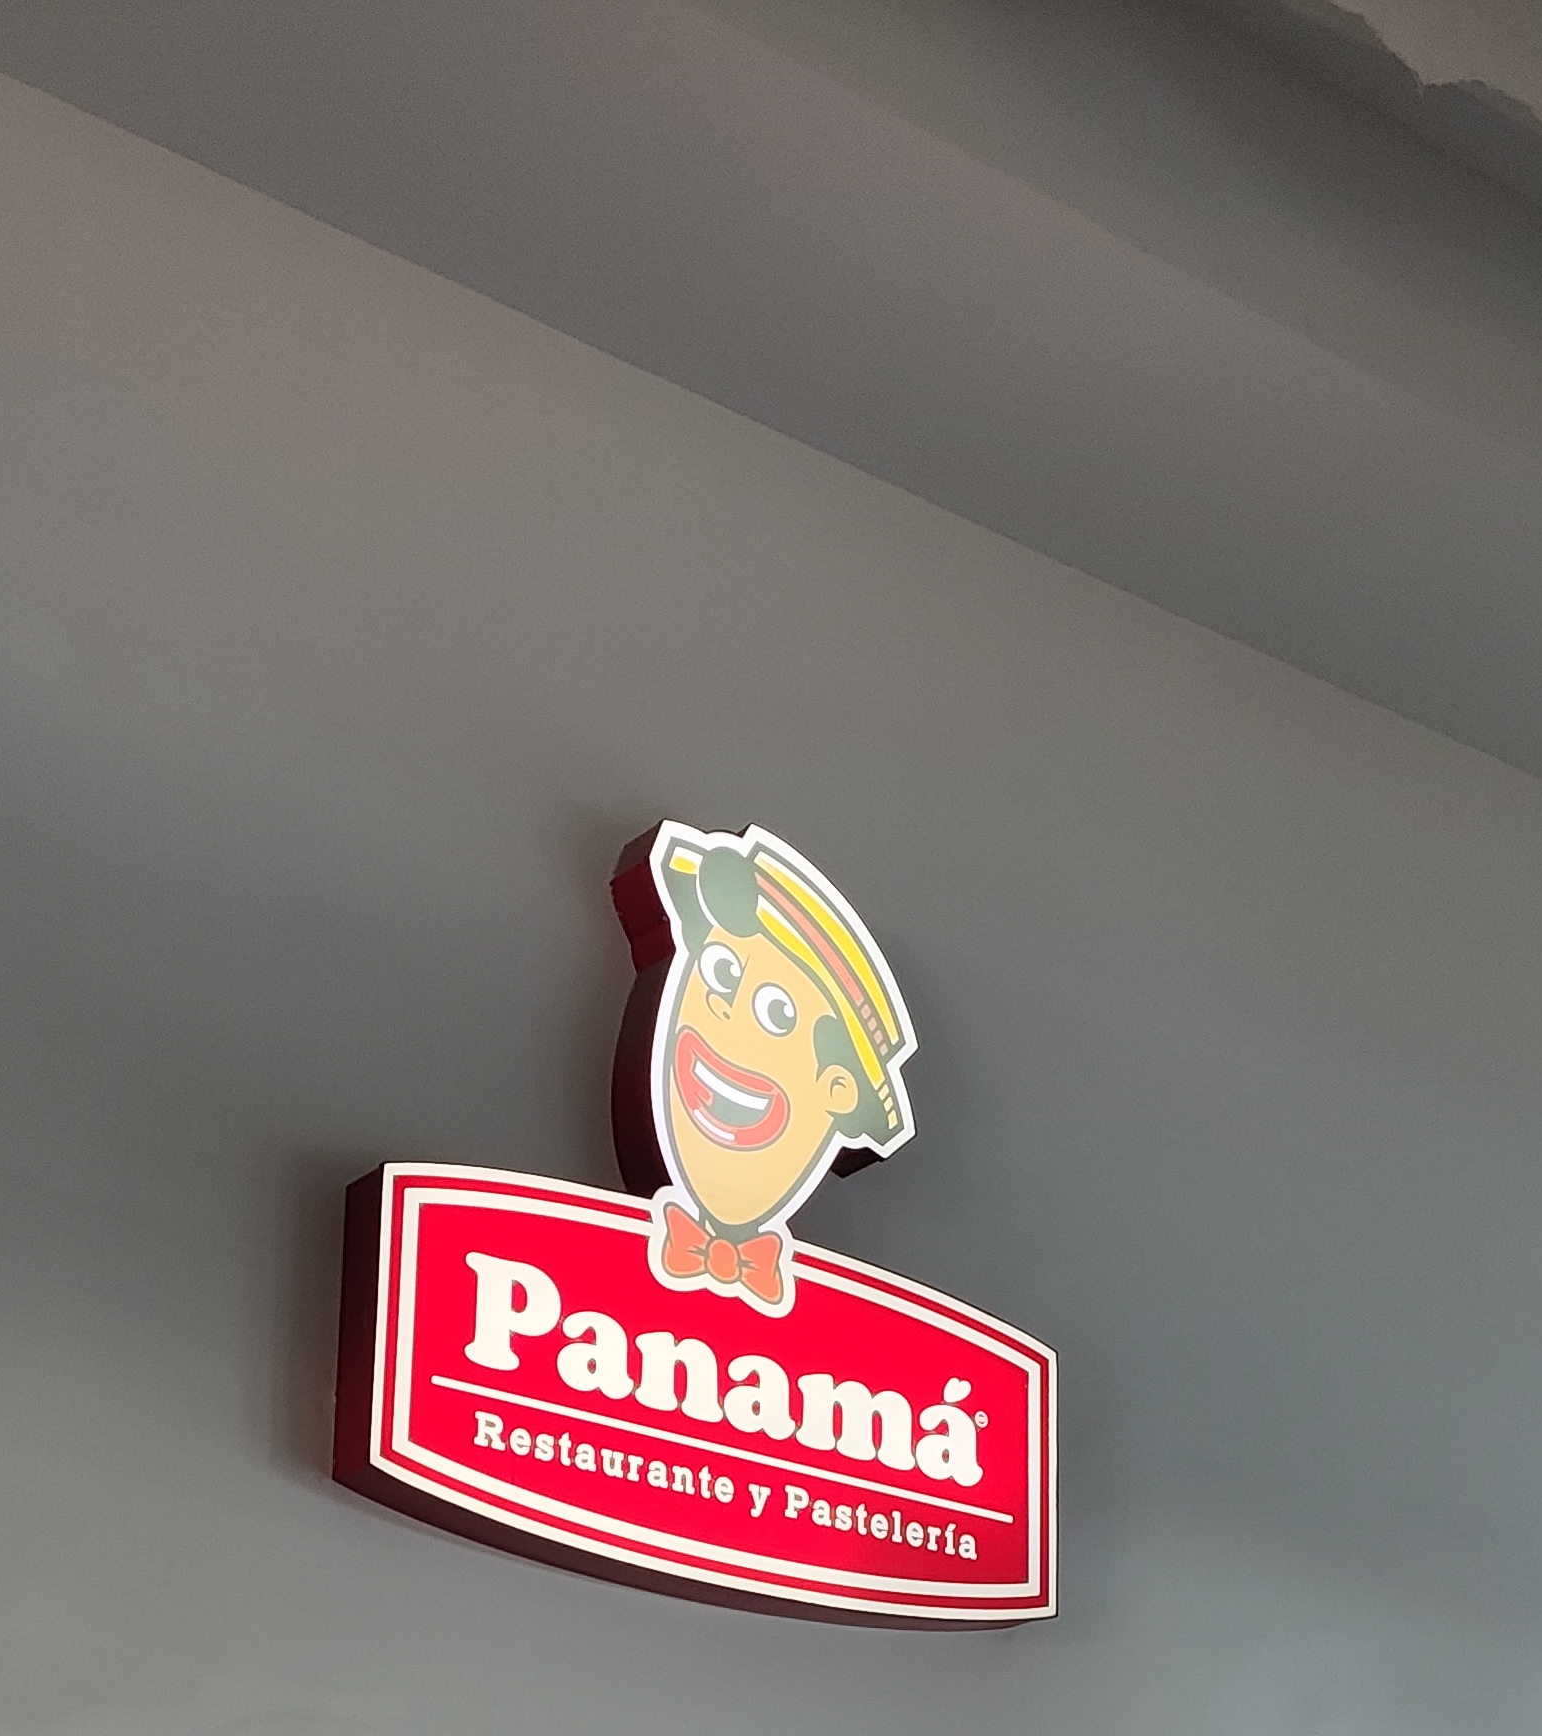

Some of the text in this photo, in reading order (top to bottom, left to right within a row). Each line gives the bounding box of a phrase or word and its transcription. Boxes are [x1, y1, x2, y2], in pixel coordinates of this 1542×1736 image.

[464, 1251, 984, 1487] Panamá
[473, 1410, 978, 1562] Restaurante y Pastelería
